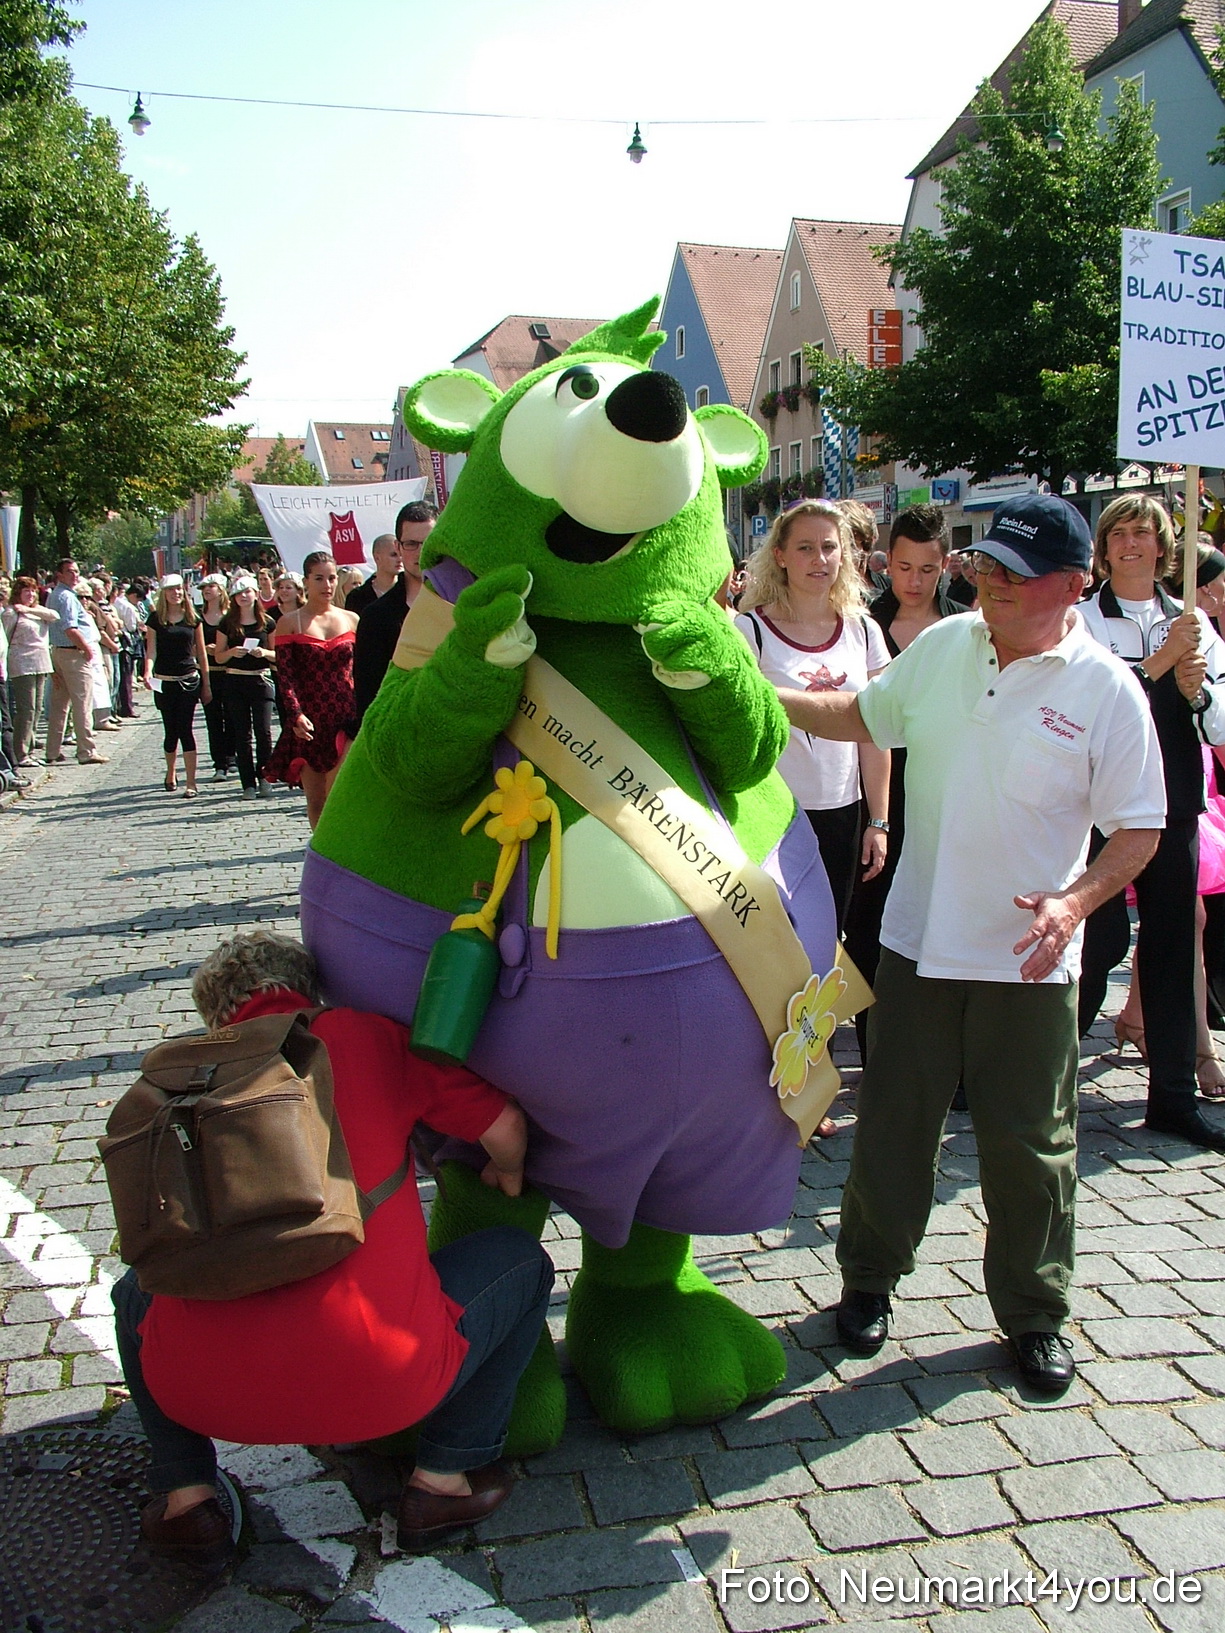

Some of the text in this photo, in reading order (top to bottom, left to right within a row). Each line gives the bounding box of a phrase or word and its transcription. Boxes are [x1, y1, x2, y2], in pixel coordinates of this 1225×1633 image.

[1173, 250, 1225, 280] TSA
[1127, 276, 1225, 309] BLAU-SI
[873, 310, 887, 369] ELE
[1123, 321, 1225, 350] TRADITIO
[1136, 366, 1225, 413] AN DE
[269, 492, 401, 510] LEICHTATHLETIK
[335, 527, 355, 543] ASV
[755, 518, 764, 535] P
[1040, 717, 1075, 740] Ringen
[542, 714, 604, 771] macht
[607, 765, 761, 929] BÄRENSTARK
